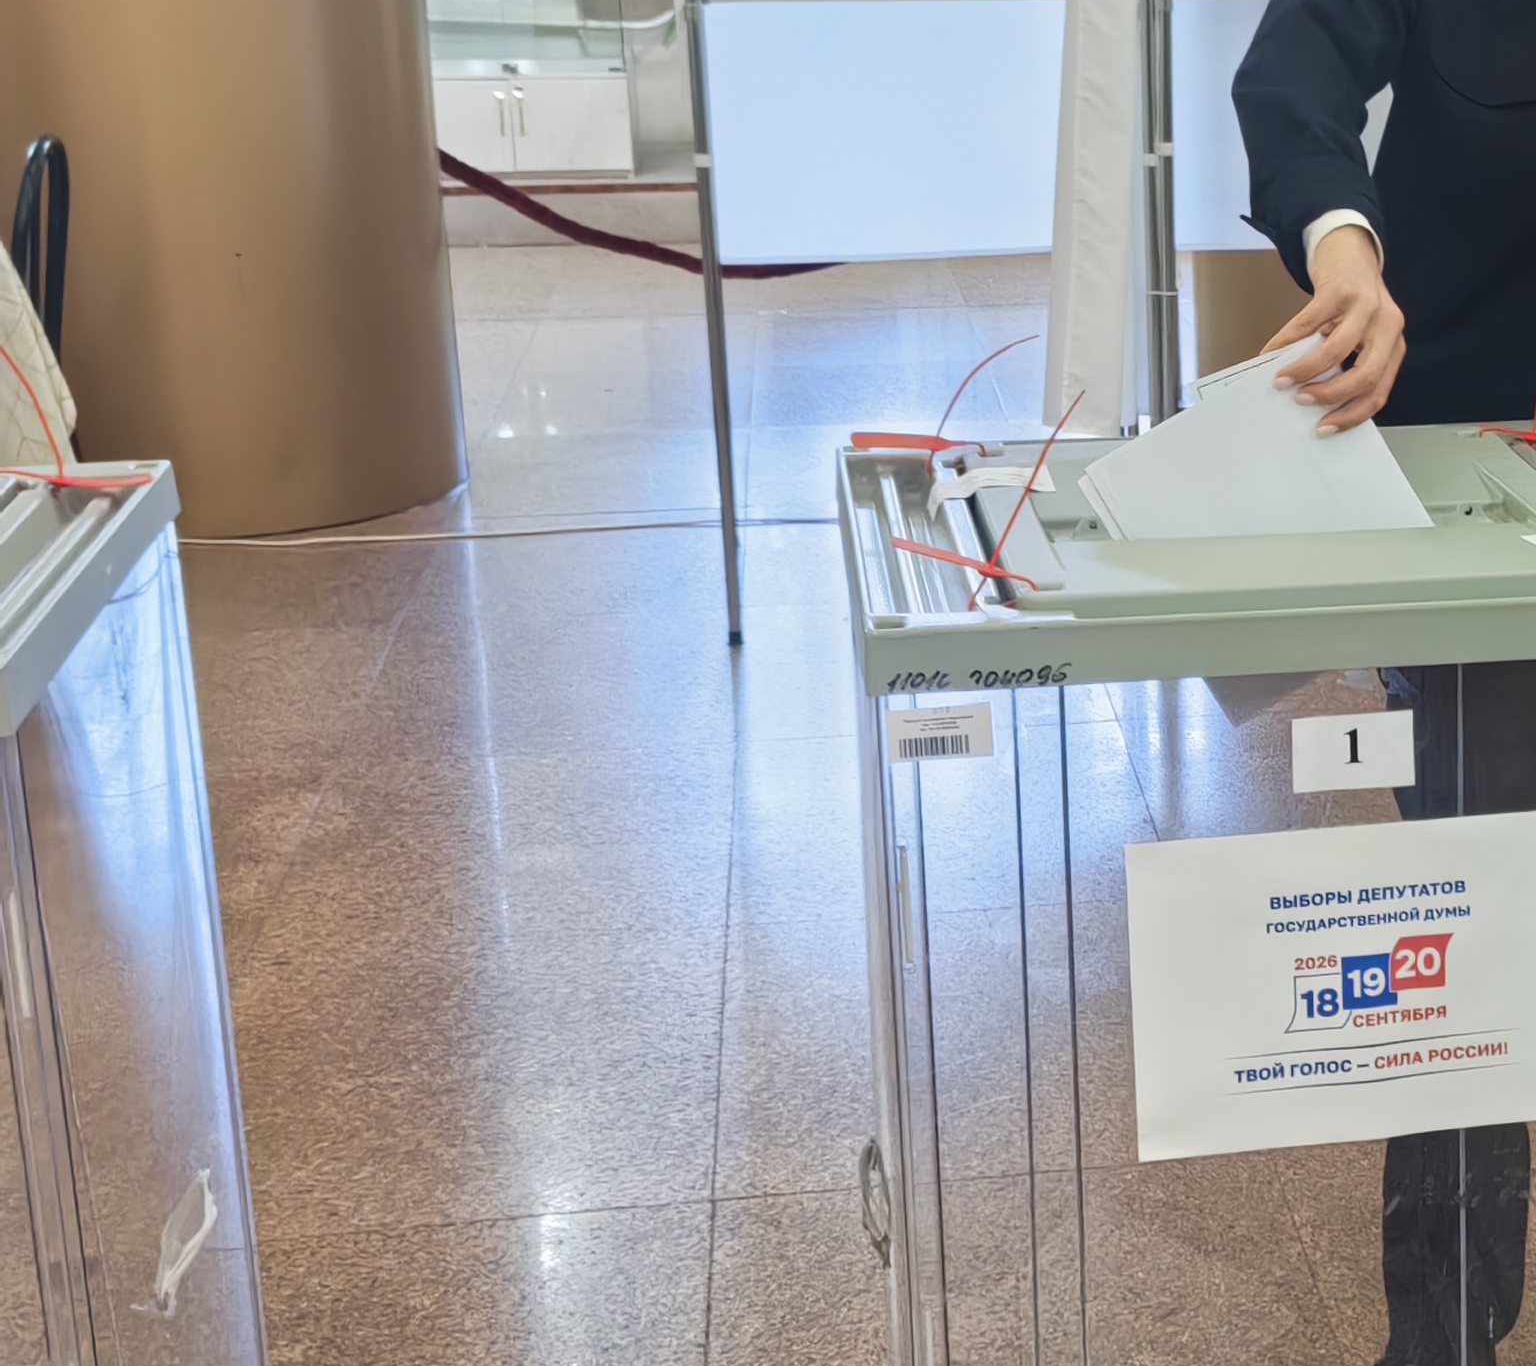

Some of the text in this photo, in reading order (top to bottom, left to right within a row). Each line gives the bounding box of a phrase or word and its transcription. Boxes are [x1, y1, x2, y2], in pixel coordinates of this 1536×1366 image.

[1343, 727, 1364, 765] 1
[1270, 880, 1467, 910] ВЫБОРЫ ДЕПУТАТОВ
[1266, 905, 1471, 935] ГОСУДАРСТВЕННОЙ ДУМЫ
[1294, 955, 1338, 971] 2026
[1301, 946, 1442, 1019] 18 19 20
[1352, 1005, 1447, 1028] СЕНТЯБРЯ
[1234, 1062, 1285, 1084] ТВОЙ
[1290, 1059, 1353, 1078] ГОЛОС
[1374, 1051, 1423, 1070] СИЛА
[1428, 1041, 1509, 1063] РОССИИ!
